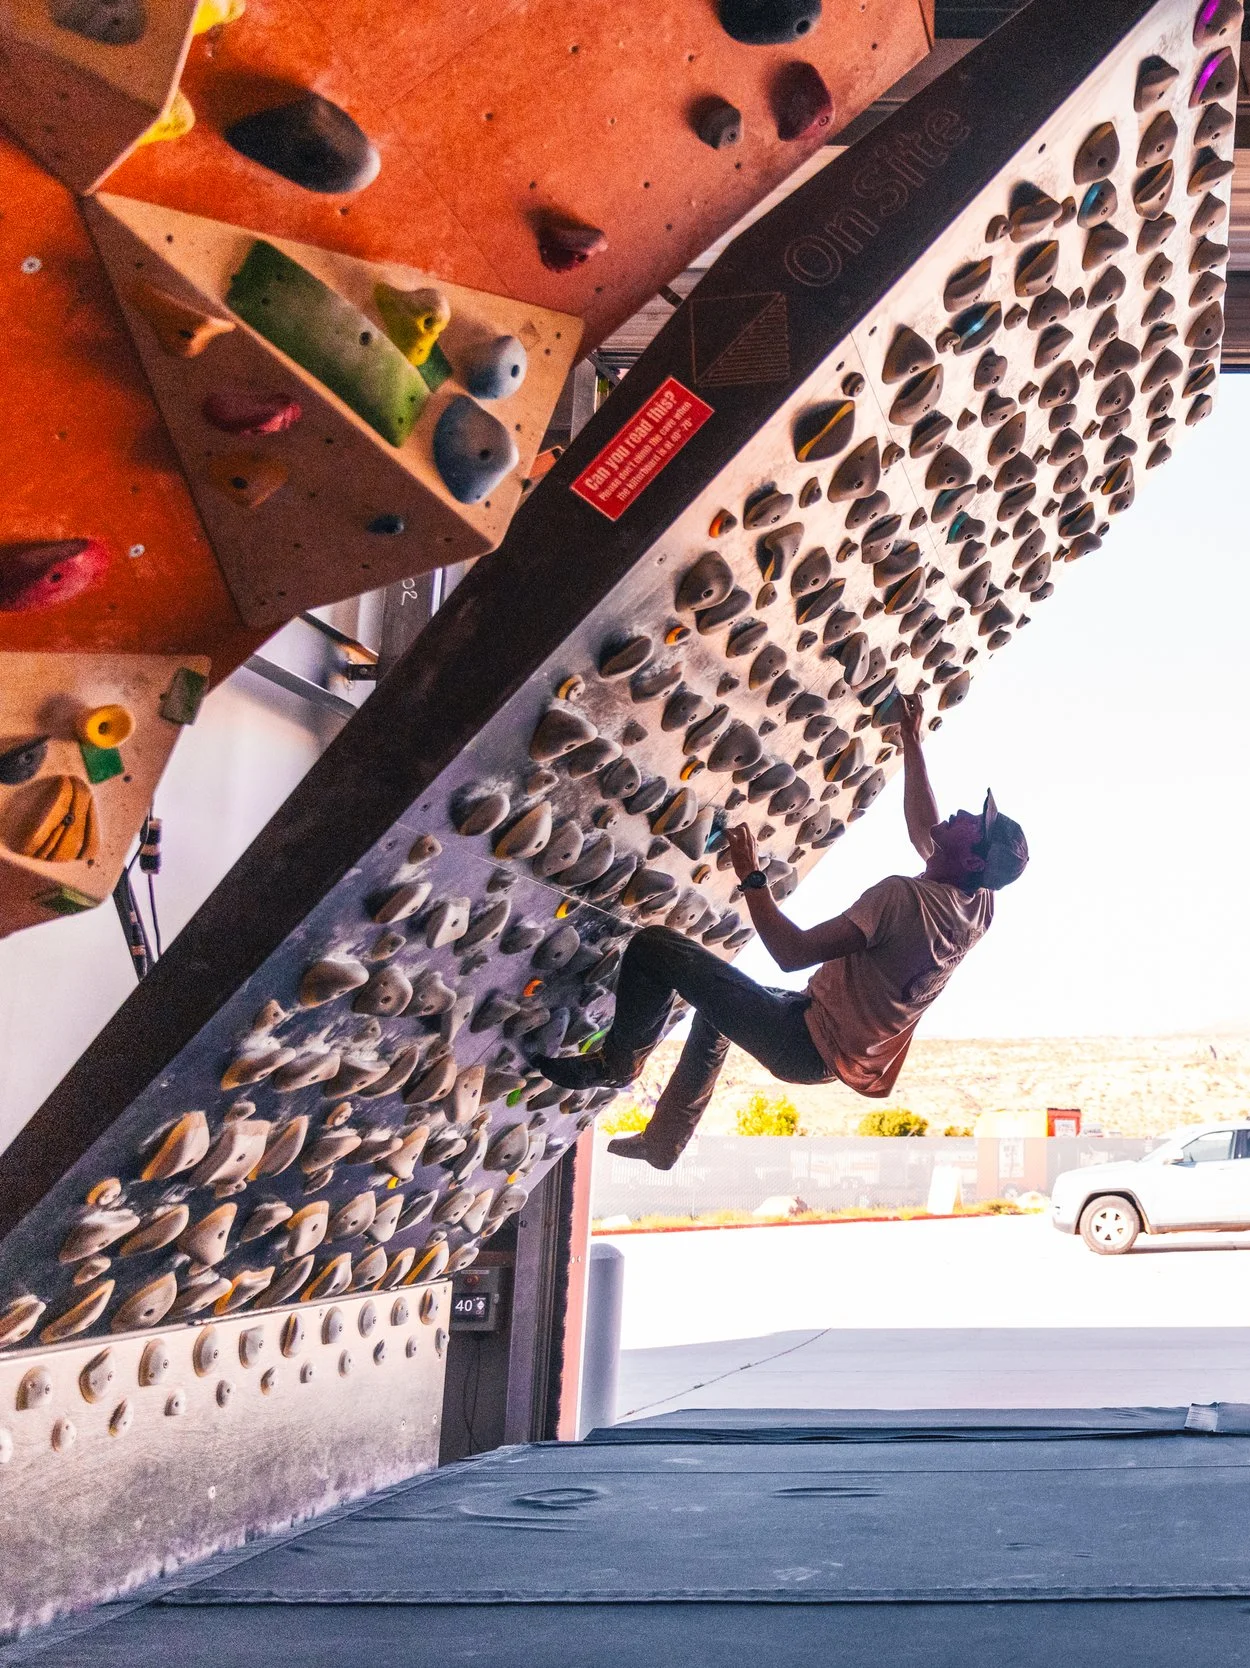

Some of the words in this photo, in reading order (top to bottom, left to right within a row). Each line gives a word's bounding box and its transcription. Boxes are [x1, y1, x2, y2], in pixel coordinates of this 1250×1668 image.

[584, 466, 611, 491] Can
[606, 444, 631, 471] you
[624, 418, 655, 447] read
[647, 391, 677, 424] this?
[599, 478, 622, 502] Please
[618, 462, 636, 481] don't
[633, 444, 652, 466] climb
[648, 432, 663, 447] the
[659, 418, 677, 436] cave
[673, 401, 693, 421] when
[616, 487, 631, 501] the
[663, 440, 675, 451] at
